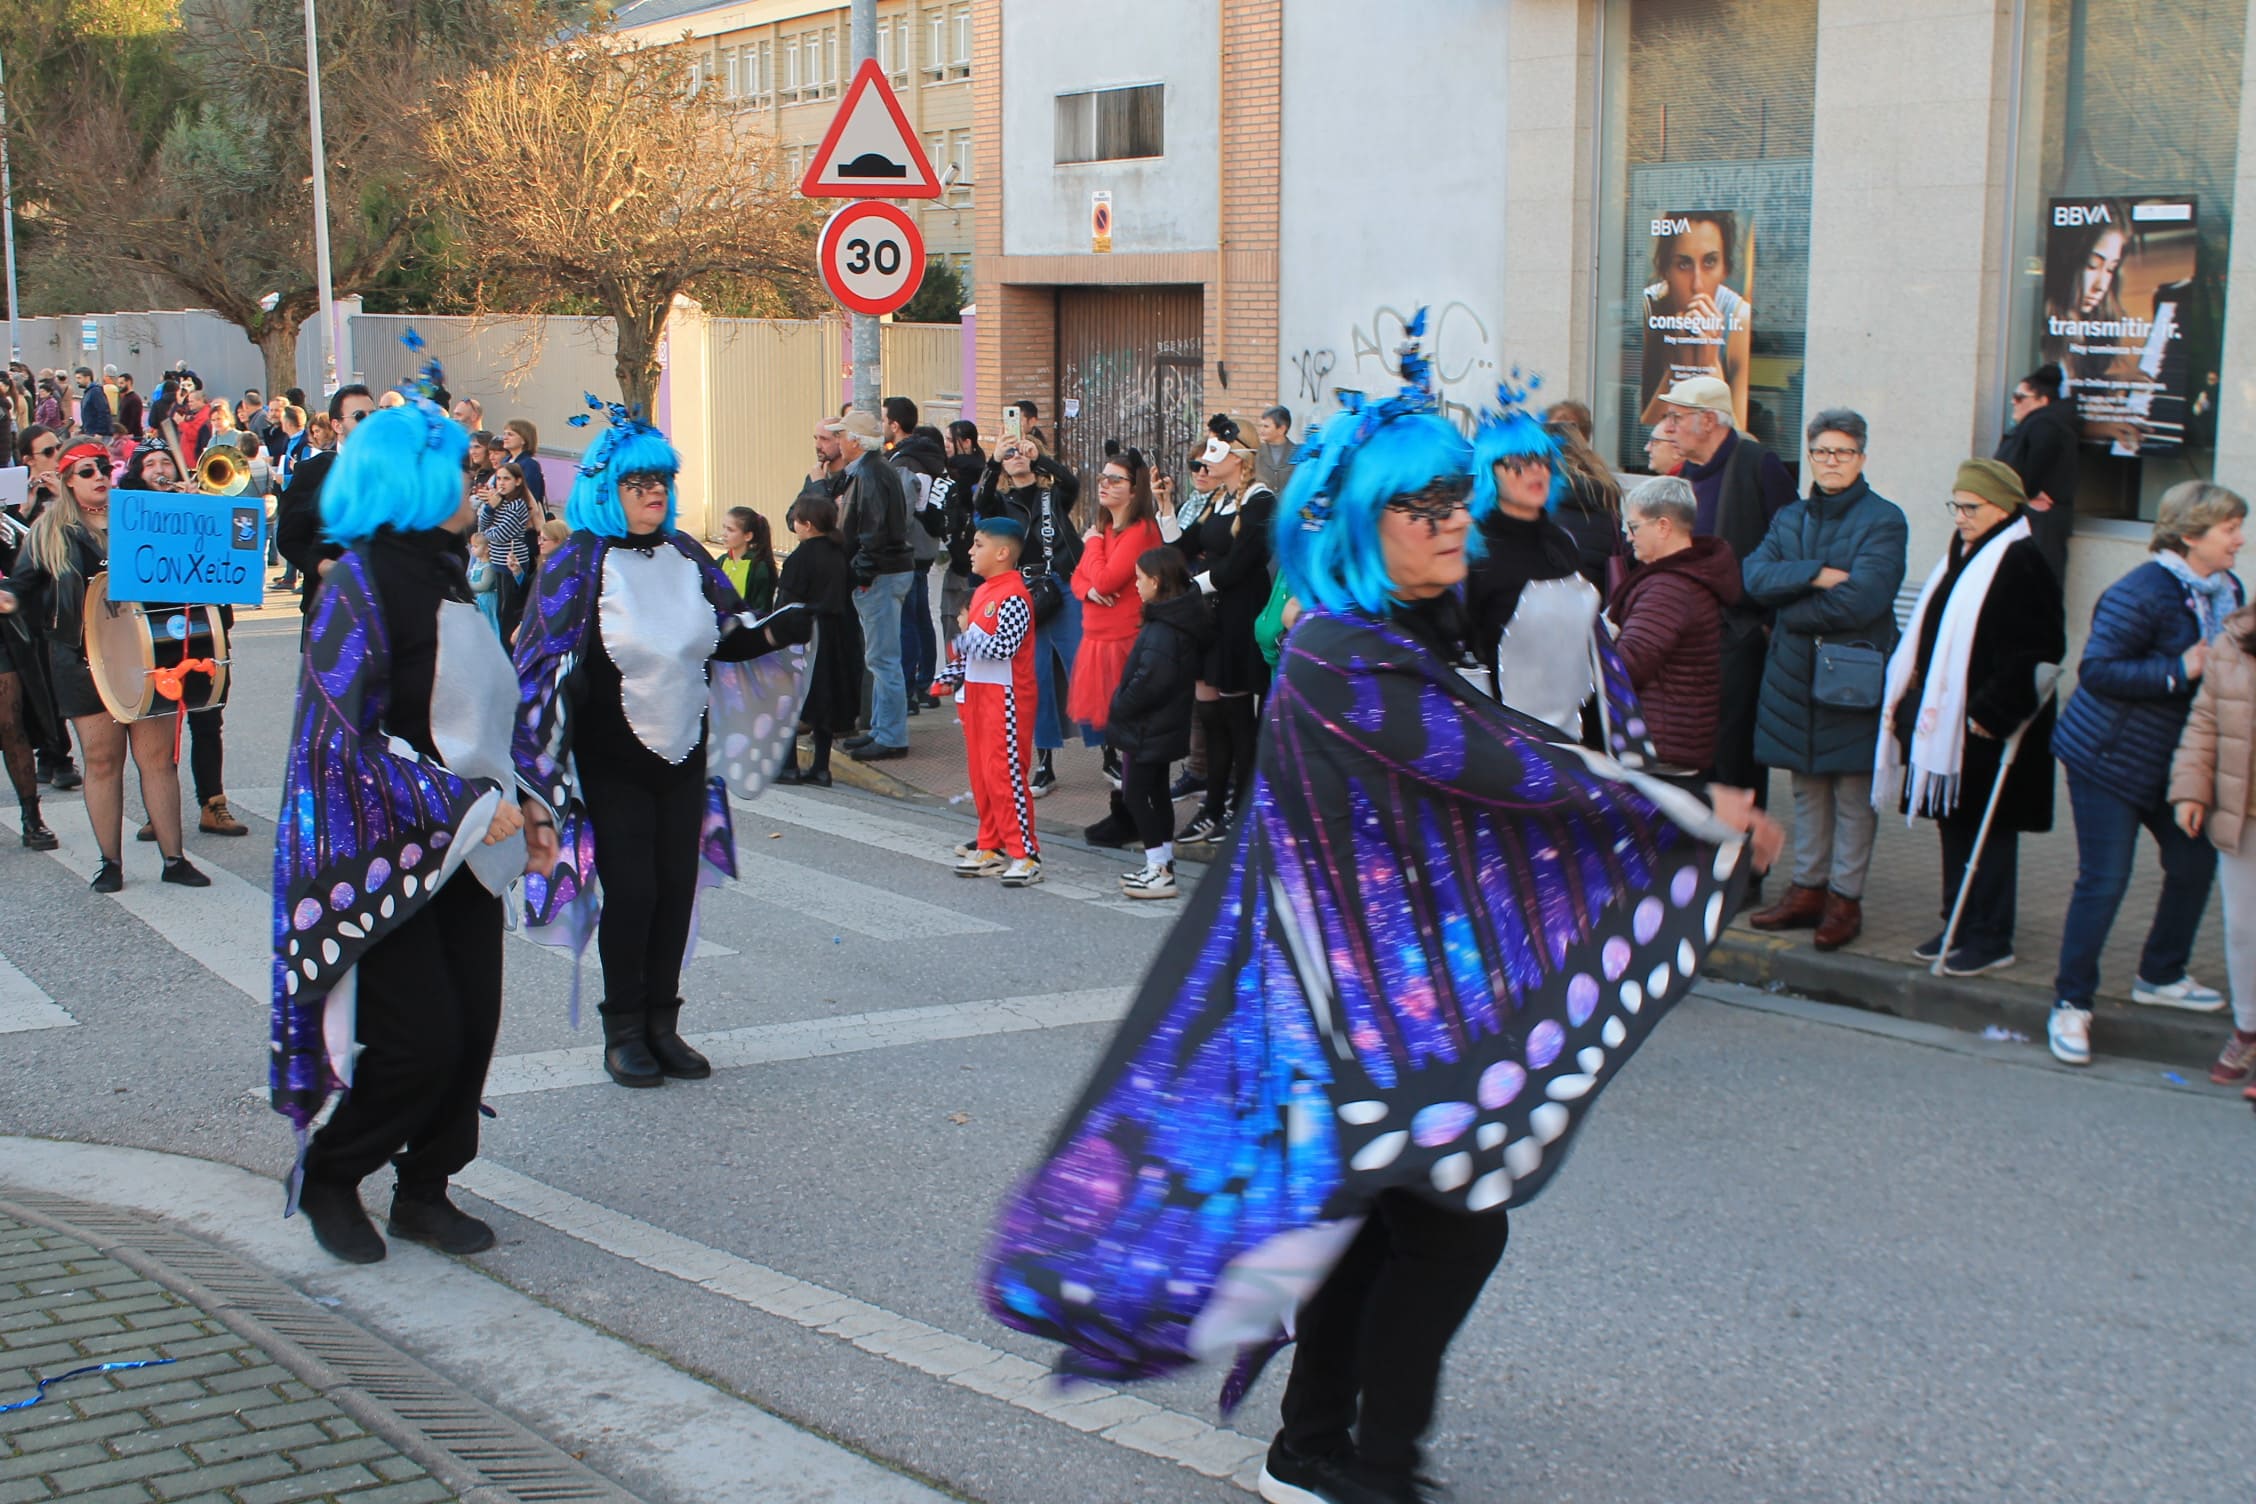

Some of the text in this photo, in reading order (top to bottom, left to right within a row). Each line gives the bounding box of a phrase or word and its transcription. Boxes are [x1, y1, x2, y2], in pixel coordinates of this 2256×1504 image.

[2053, 204, 2112, 226] BBVA
[1650, 217, 1692, 236] BBVA
[846, 238, 901, 275] 30
[1649, 313, 1743, 334] conseguir. ir.
[121, 496, 223, 552] Charanga
